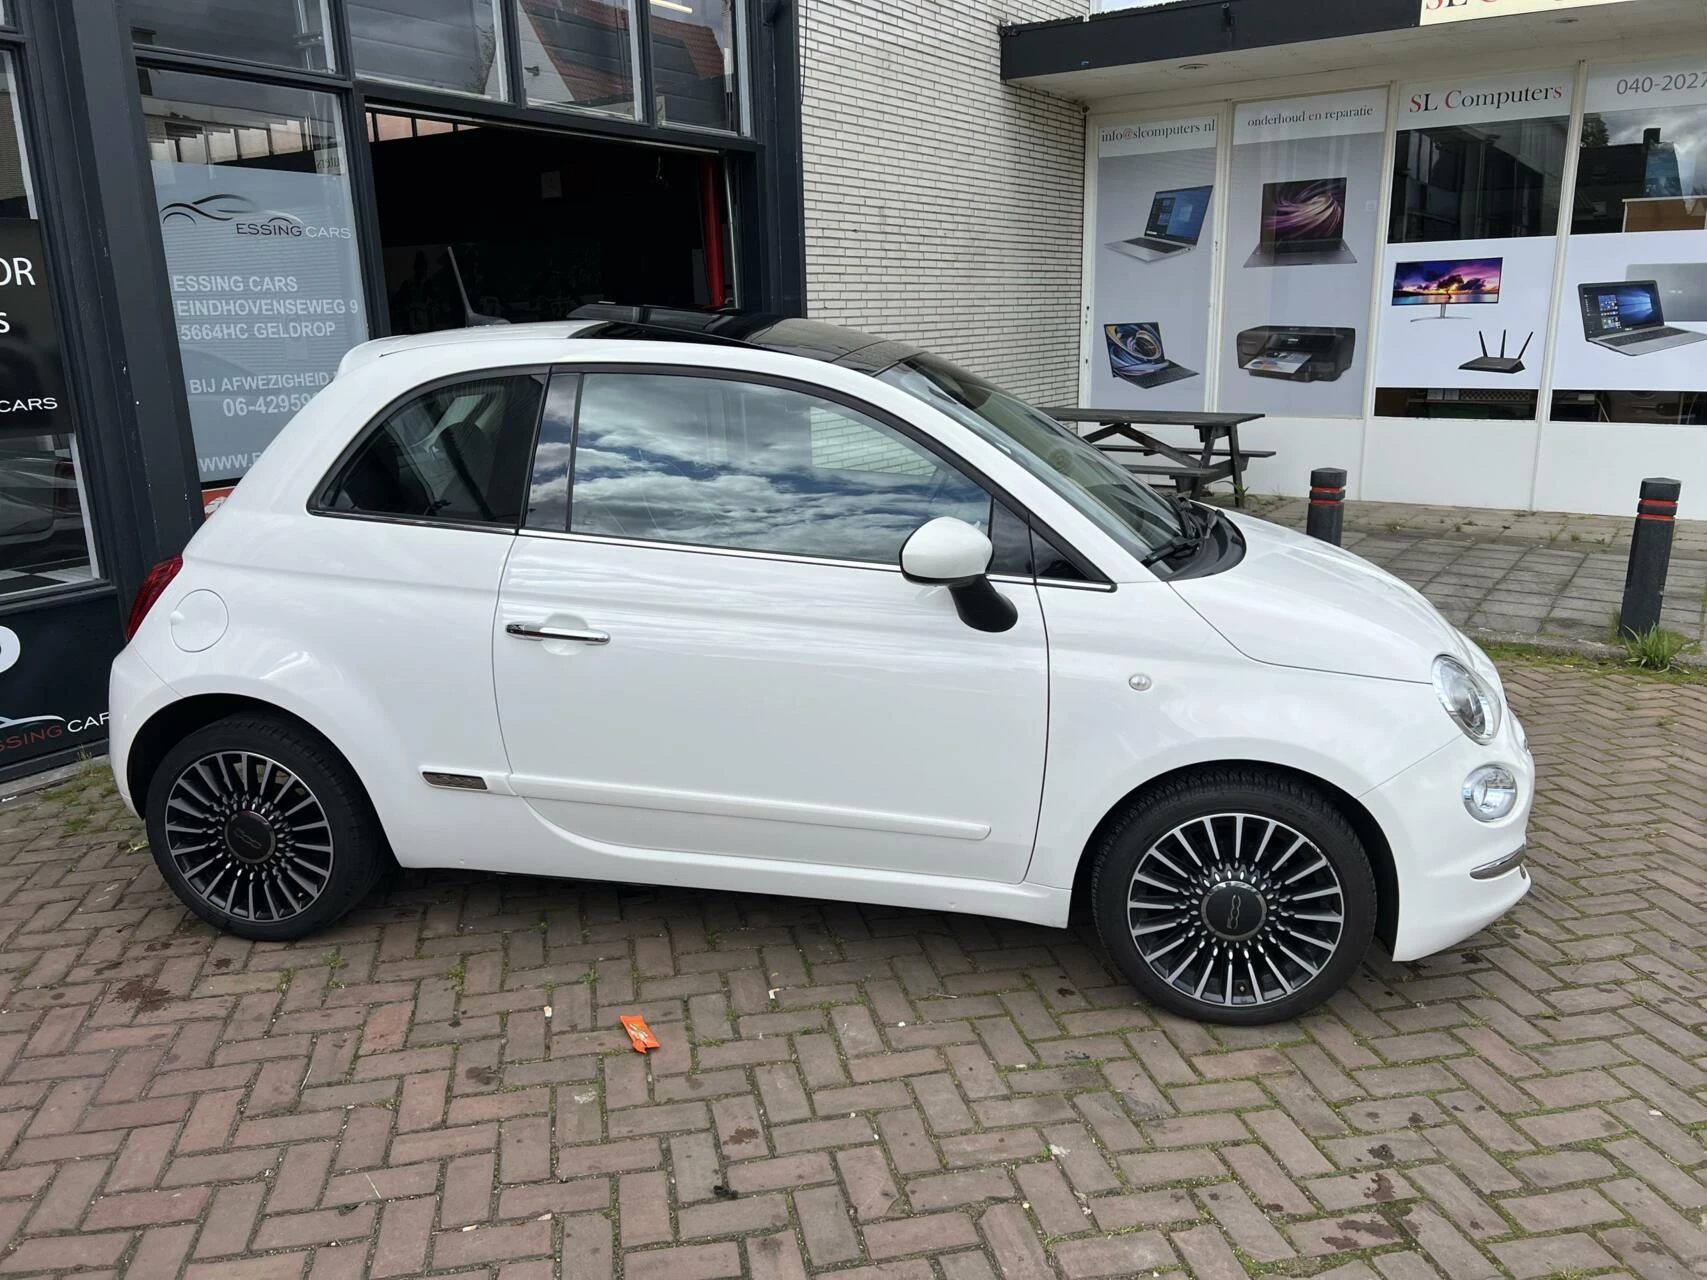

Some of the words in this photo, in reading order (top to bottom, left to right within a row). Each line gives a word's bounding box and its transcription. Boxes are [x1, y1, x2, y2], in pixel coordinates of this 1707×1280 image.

[1409, 93, 1438, 113] SL
[1445, 85, 1563, 109] Computers
[1247, 111, 1306, 127] onderhoud
[1308, 112, 1322, 121] en
[1325, 104, 1374, 121] reparatie
[236, 222, 302, 237] ESSING
[305, 226, 352, 240] CARS
[173, 275, 244, 292] ESSING
[249, 275, 299, 292] CARS
[176, 299, 346, 316] EINDHOVENSEWEG
[350, 299, 359, 314] 9
[180, 323, 249, 341] 5664HC
[254, 321, 336, 339] GELDROP
[190, 378, 216, 394] BIJ
[221, 372, 330, 392] AFWEZIGHEID
